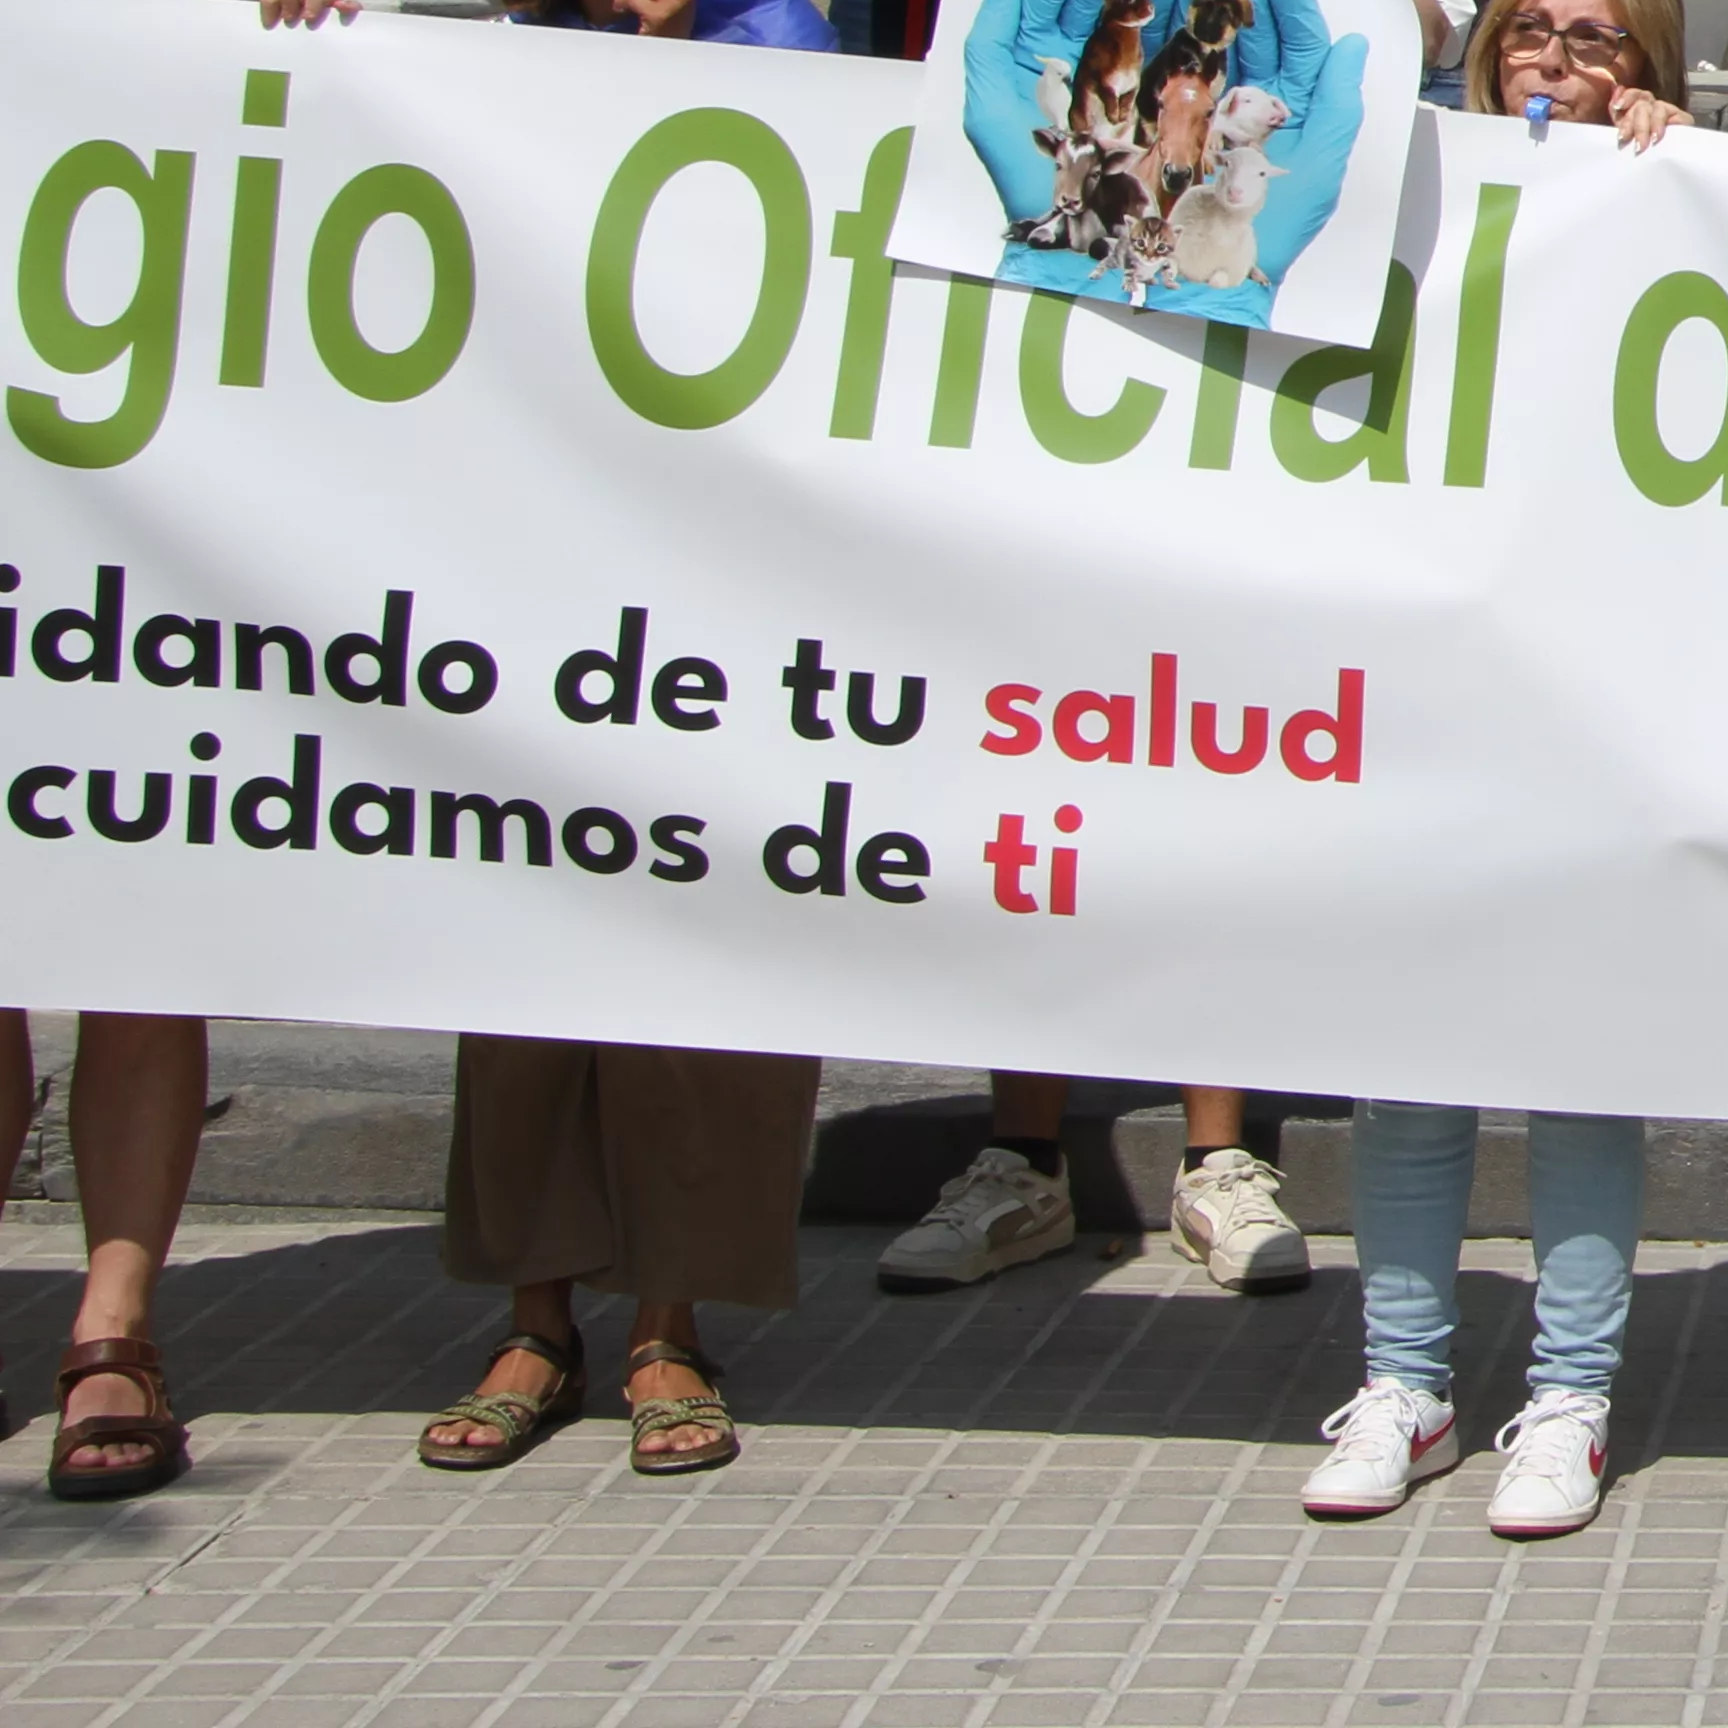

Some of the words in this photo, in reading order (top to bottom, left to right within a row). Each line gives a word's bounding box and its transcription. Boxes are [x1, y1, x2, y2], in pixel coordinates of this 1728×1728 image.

[0, 562, 500, 715] idando
[554, 605, 729, 732] de
[782, 637, 927, 747] tu
[979, 652, 1366, 784] salud
[6, 730, 711, 883] cuidamos
[762, 780, 932, 905] de
[983, 803, 1083, 917] ti
